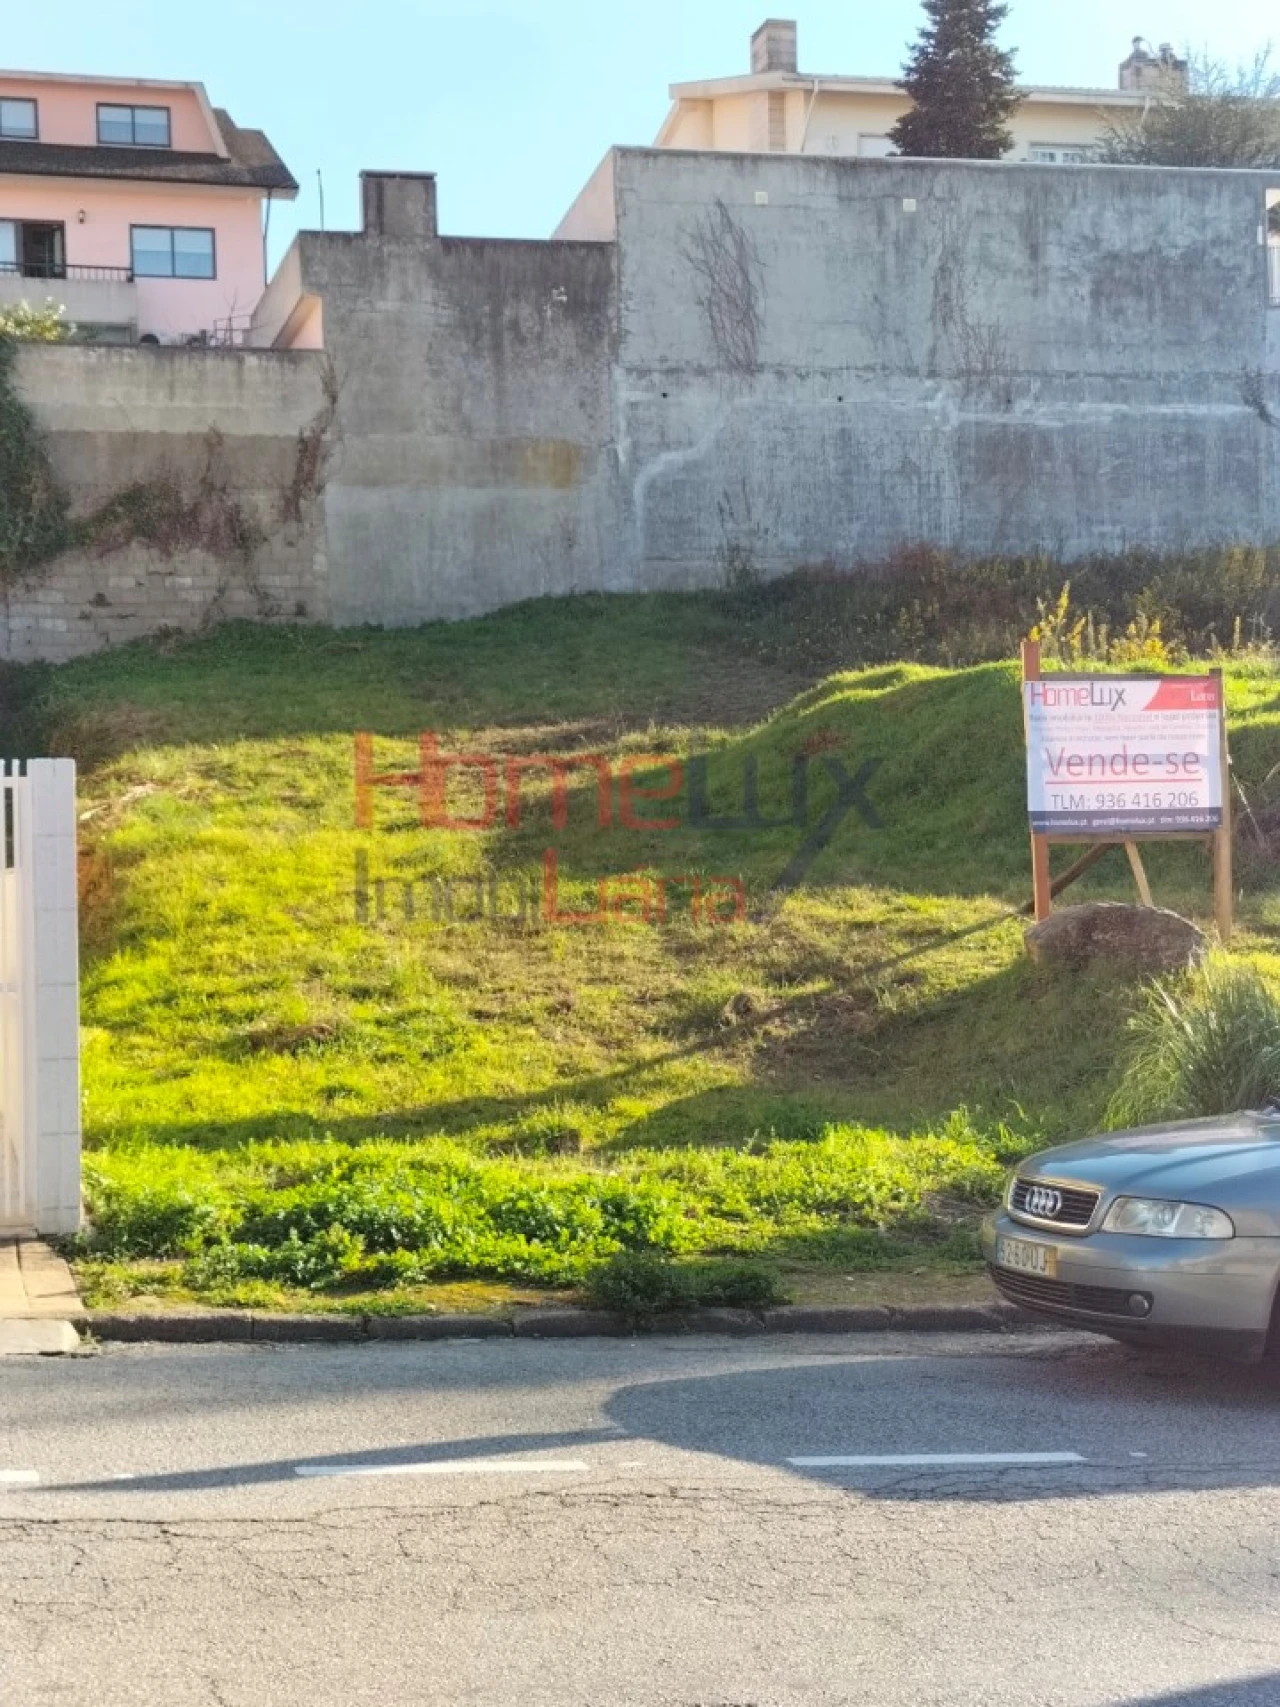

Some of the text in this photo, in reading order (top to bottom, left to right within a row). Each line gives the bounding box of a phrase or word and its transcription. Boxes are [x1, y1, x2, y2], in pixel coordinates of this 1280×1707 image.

[1045, 743, 1200, 776] Vende-se
[1051, 791, 1199, 810] TLM: 936 416 206
